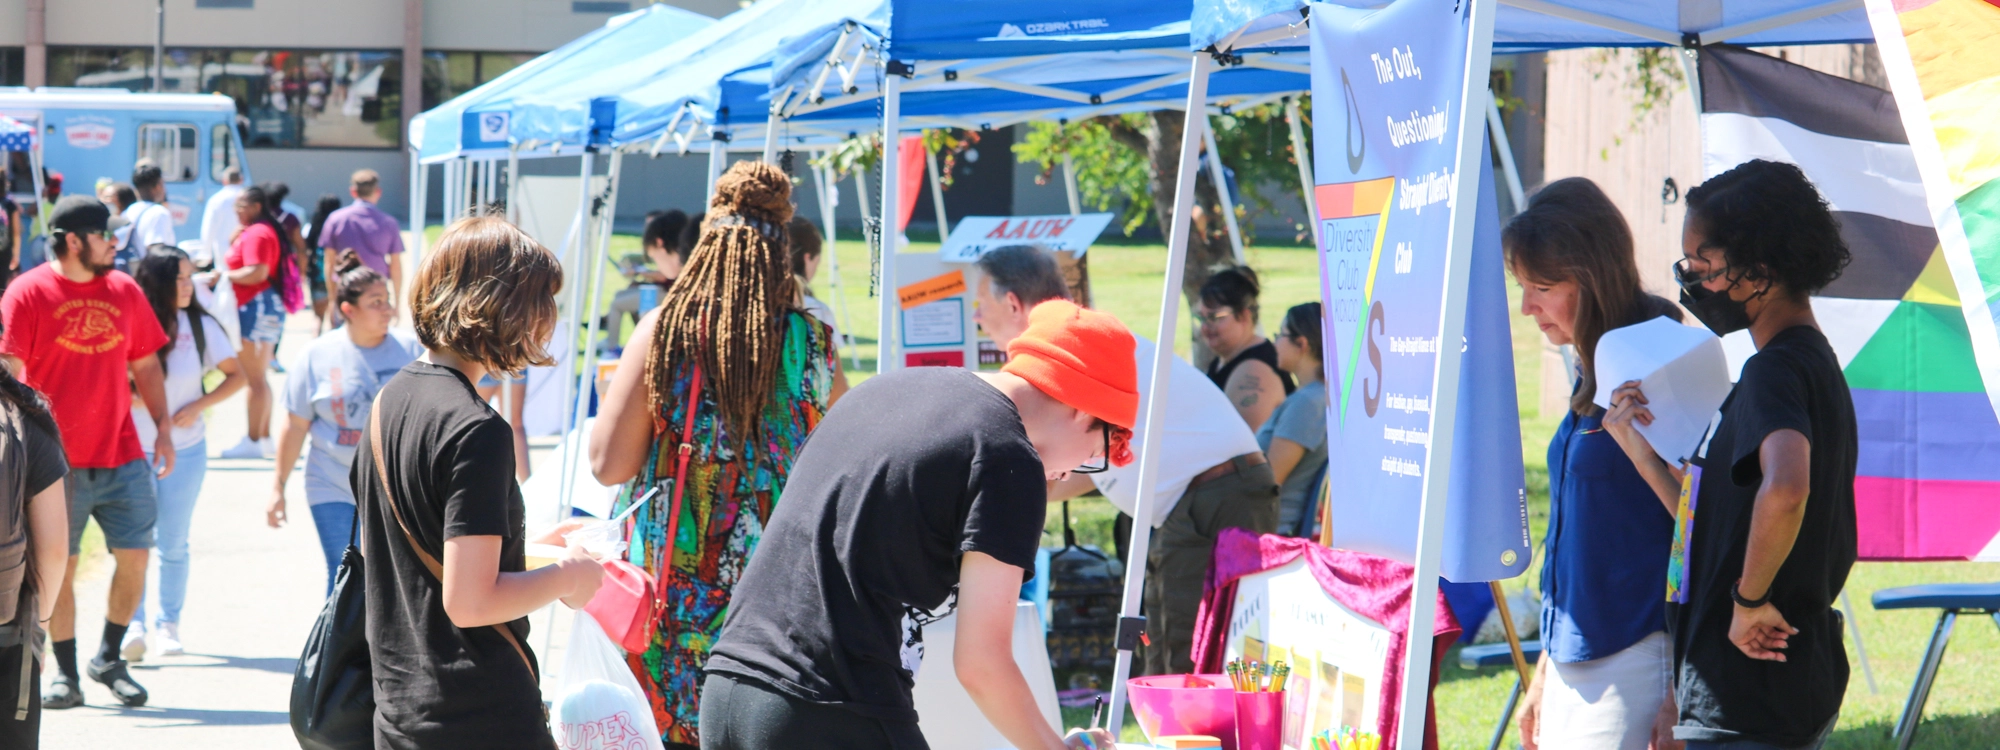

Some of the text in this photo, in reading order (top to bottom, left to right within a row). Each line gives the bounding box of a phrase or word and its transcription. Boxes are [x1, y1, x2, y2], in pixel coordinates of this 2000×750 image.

[1026, 21, 1071, 34] OZARK
[1071, 18, 1109, 29] TRAIL
[1371, 44, 1422, 84] The Out,
[985, 217, 1075, 240] AAUW
[1325, 221, 1376, 260] Diversity
[1395, 241, 1412, 274] Club
[1336, 259, 1359, 290] Club
[52, 299, 121, 319] UNITED STATES
[55, 333, 124, 354] MARINE CORPS
[557, 710, 639, 750] SUPER
